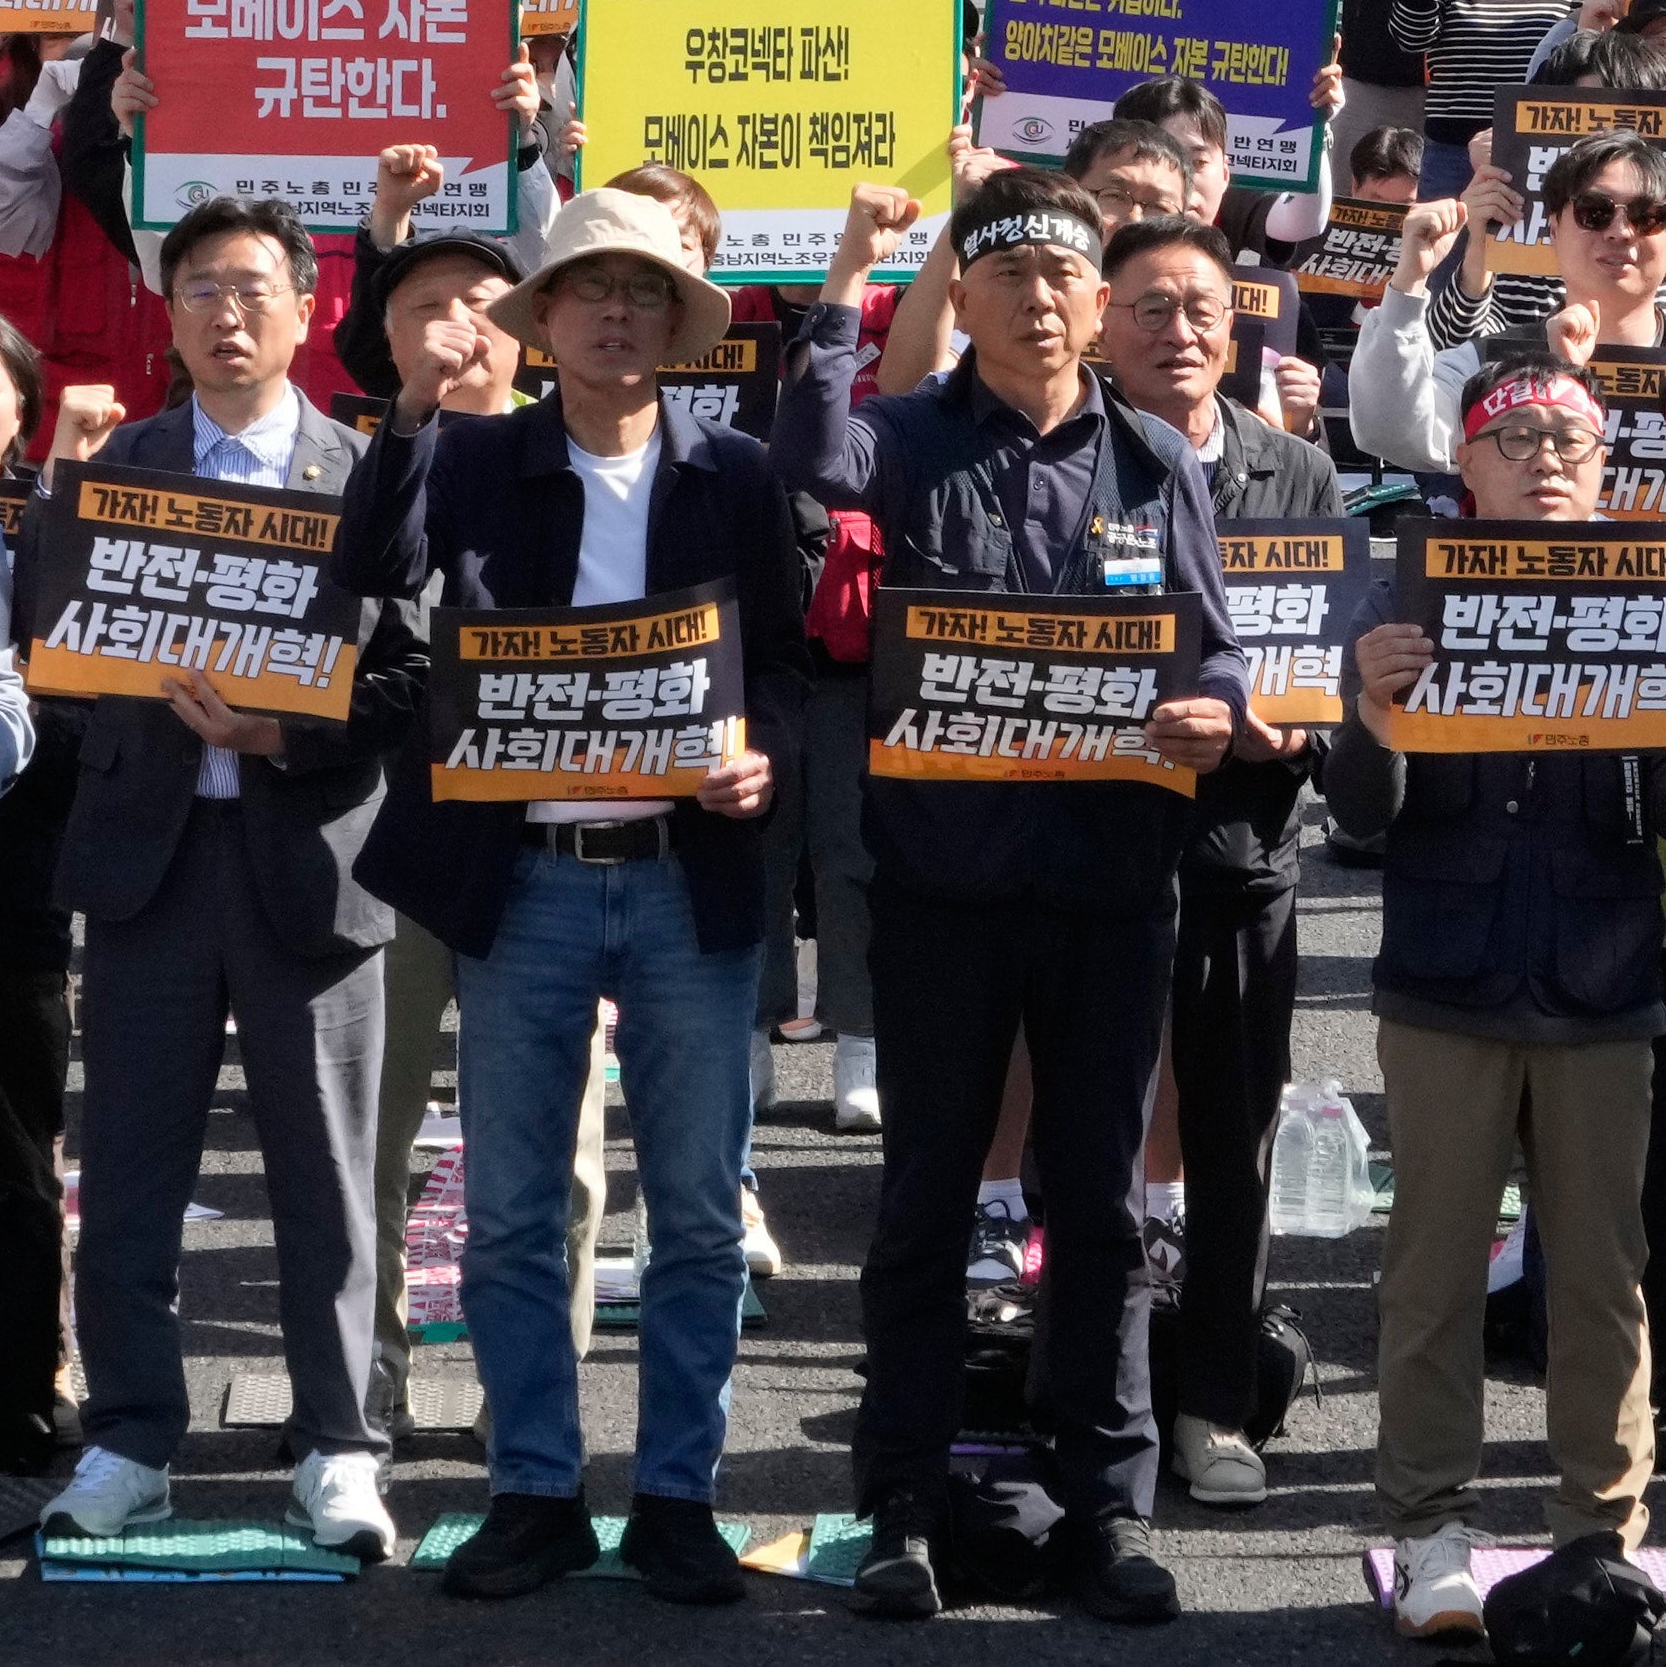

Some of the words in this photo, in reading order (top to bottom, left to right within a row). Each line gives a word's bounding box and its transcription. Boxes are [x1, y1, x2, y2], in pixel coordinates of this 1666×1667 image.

[254, 57, 446, 119] 규탄한다.
[1437, 545, 1507, 578] 가자!
[1517, 545, 1607, 578] 노동자
